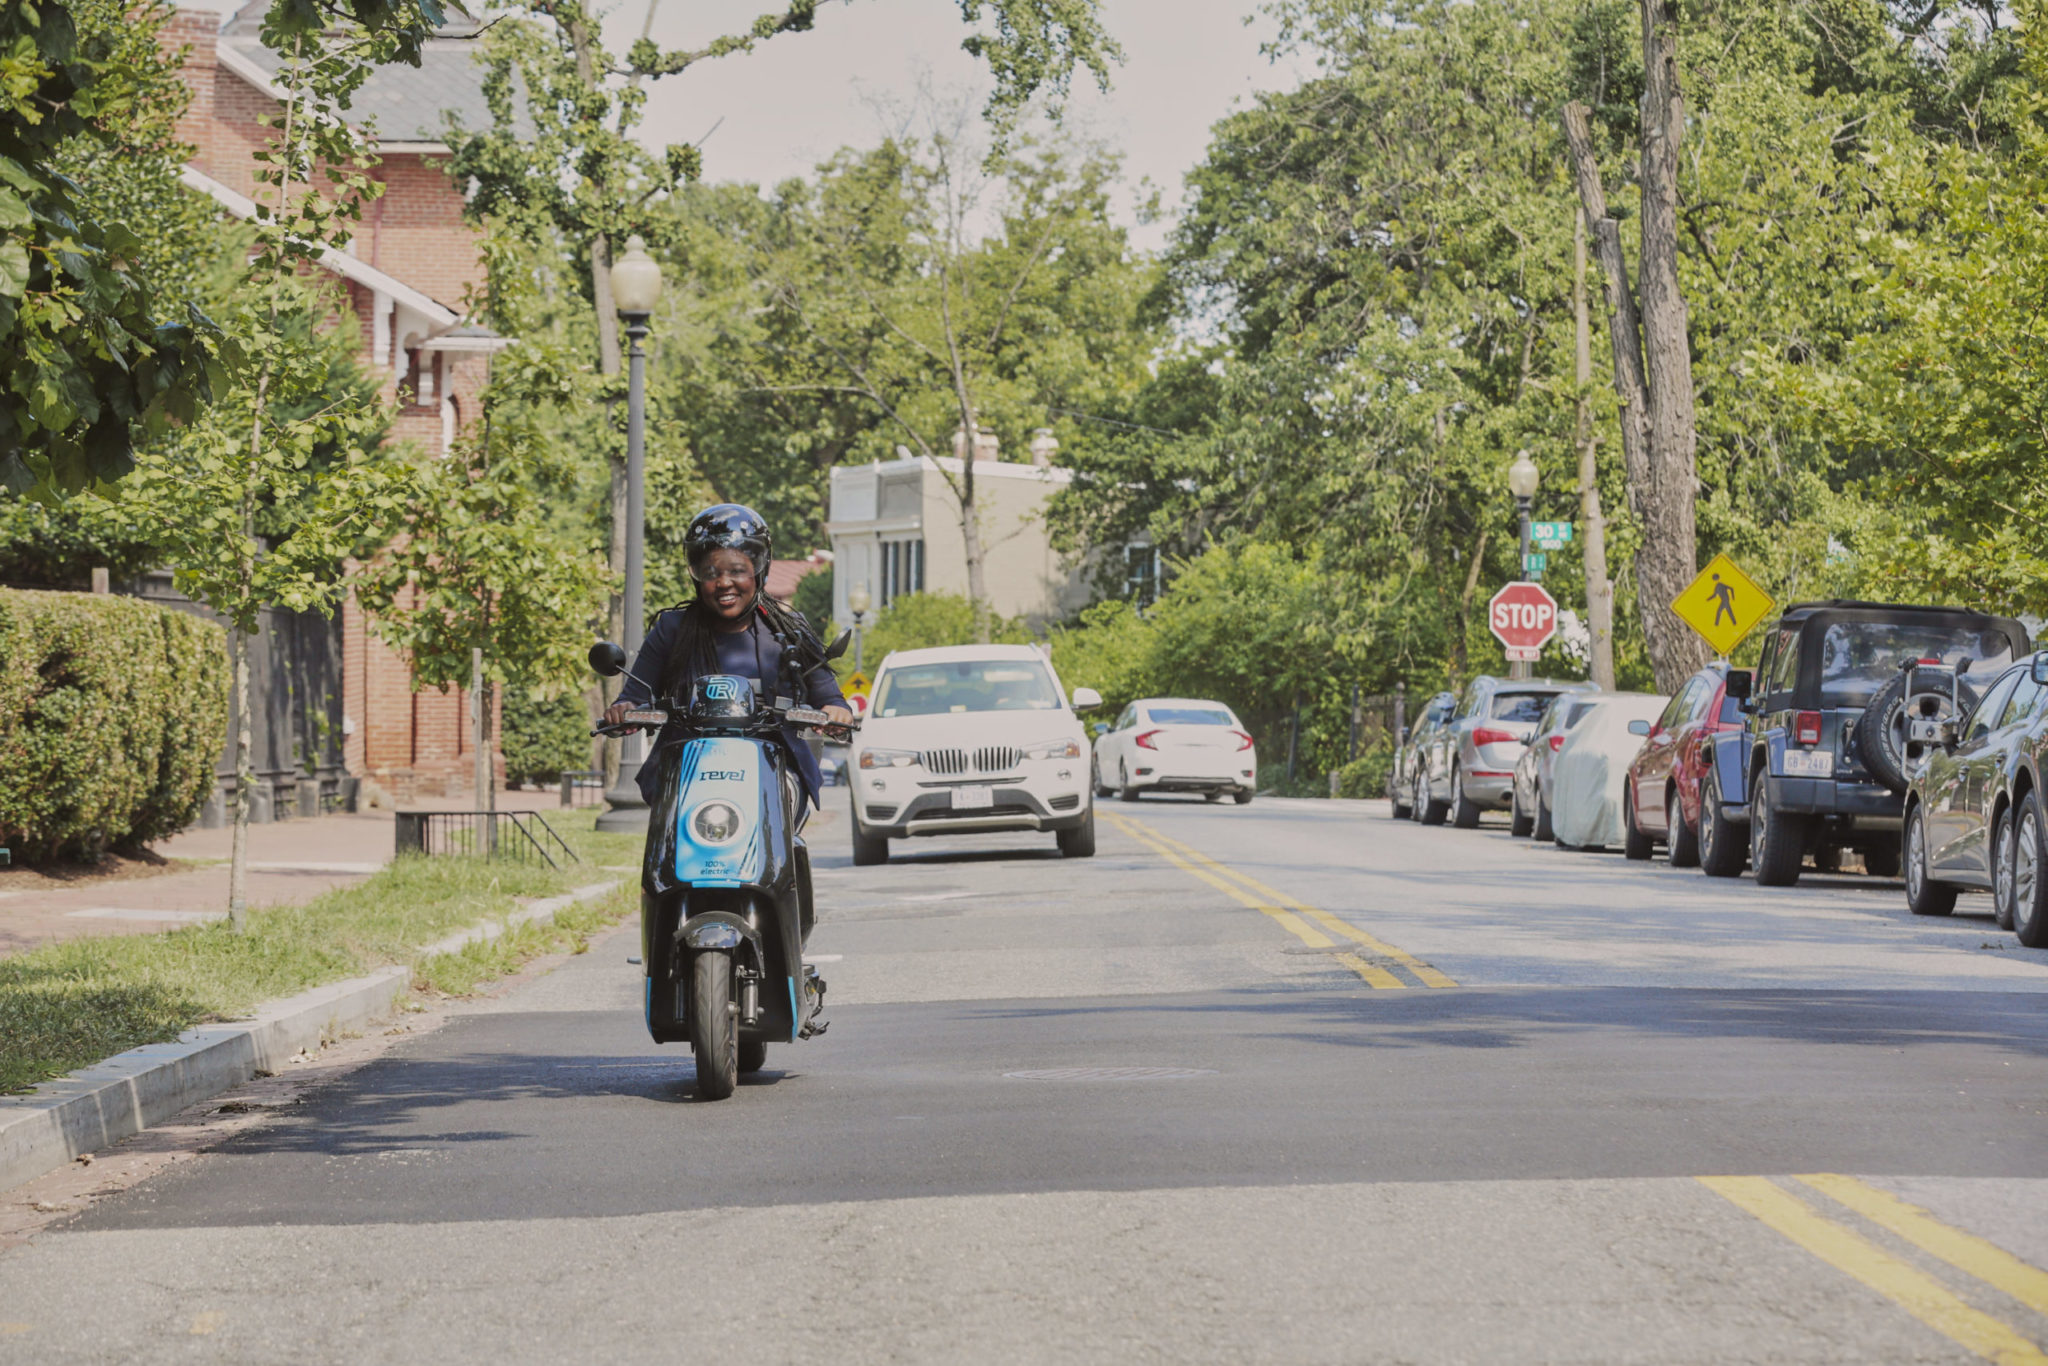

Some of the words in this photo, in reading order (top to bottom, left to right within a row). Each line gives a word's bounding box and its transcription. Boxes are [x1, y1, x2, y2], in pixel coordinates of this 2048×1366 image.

[1494, 602, 1552, 630] STOP
[699, 769, 746, 782] revel
[704, 860, 725, 868] 100%
[700, 868, 730, 876] electric
